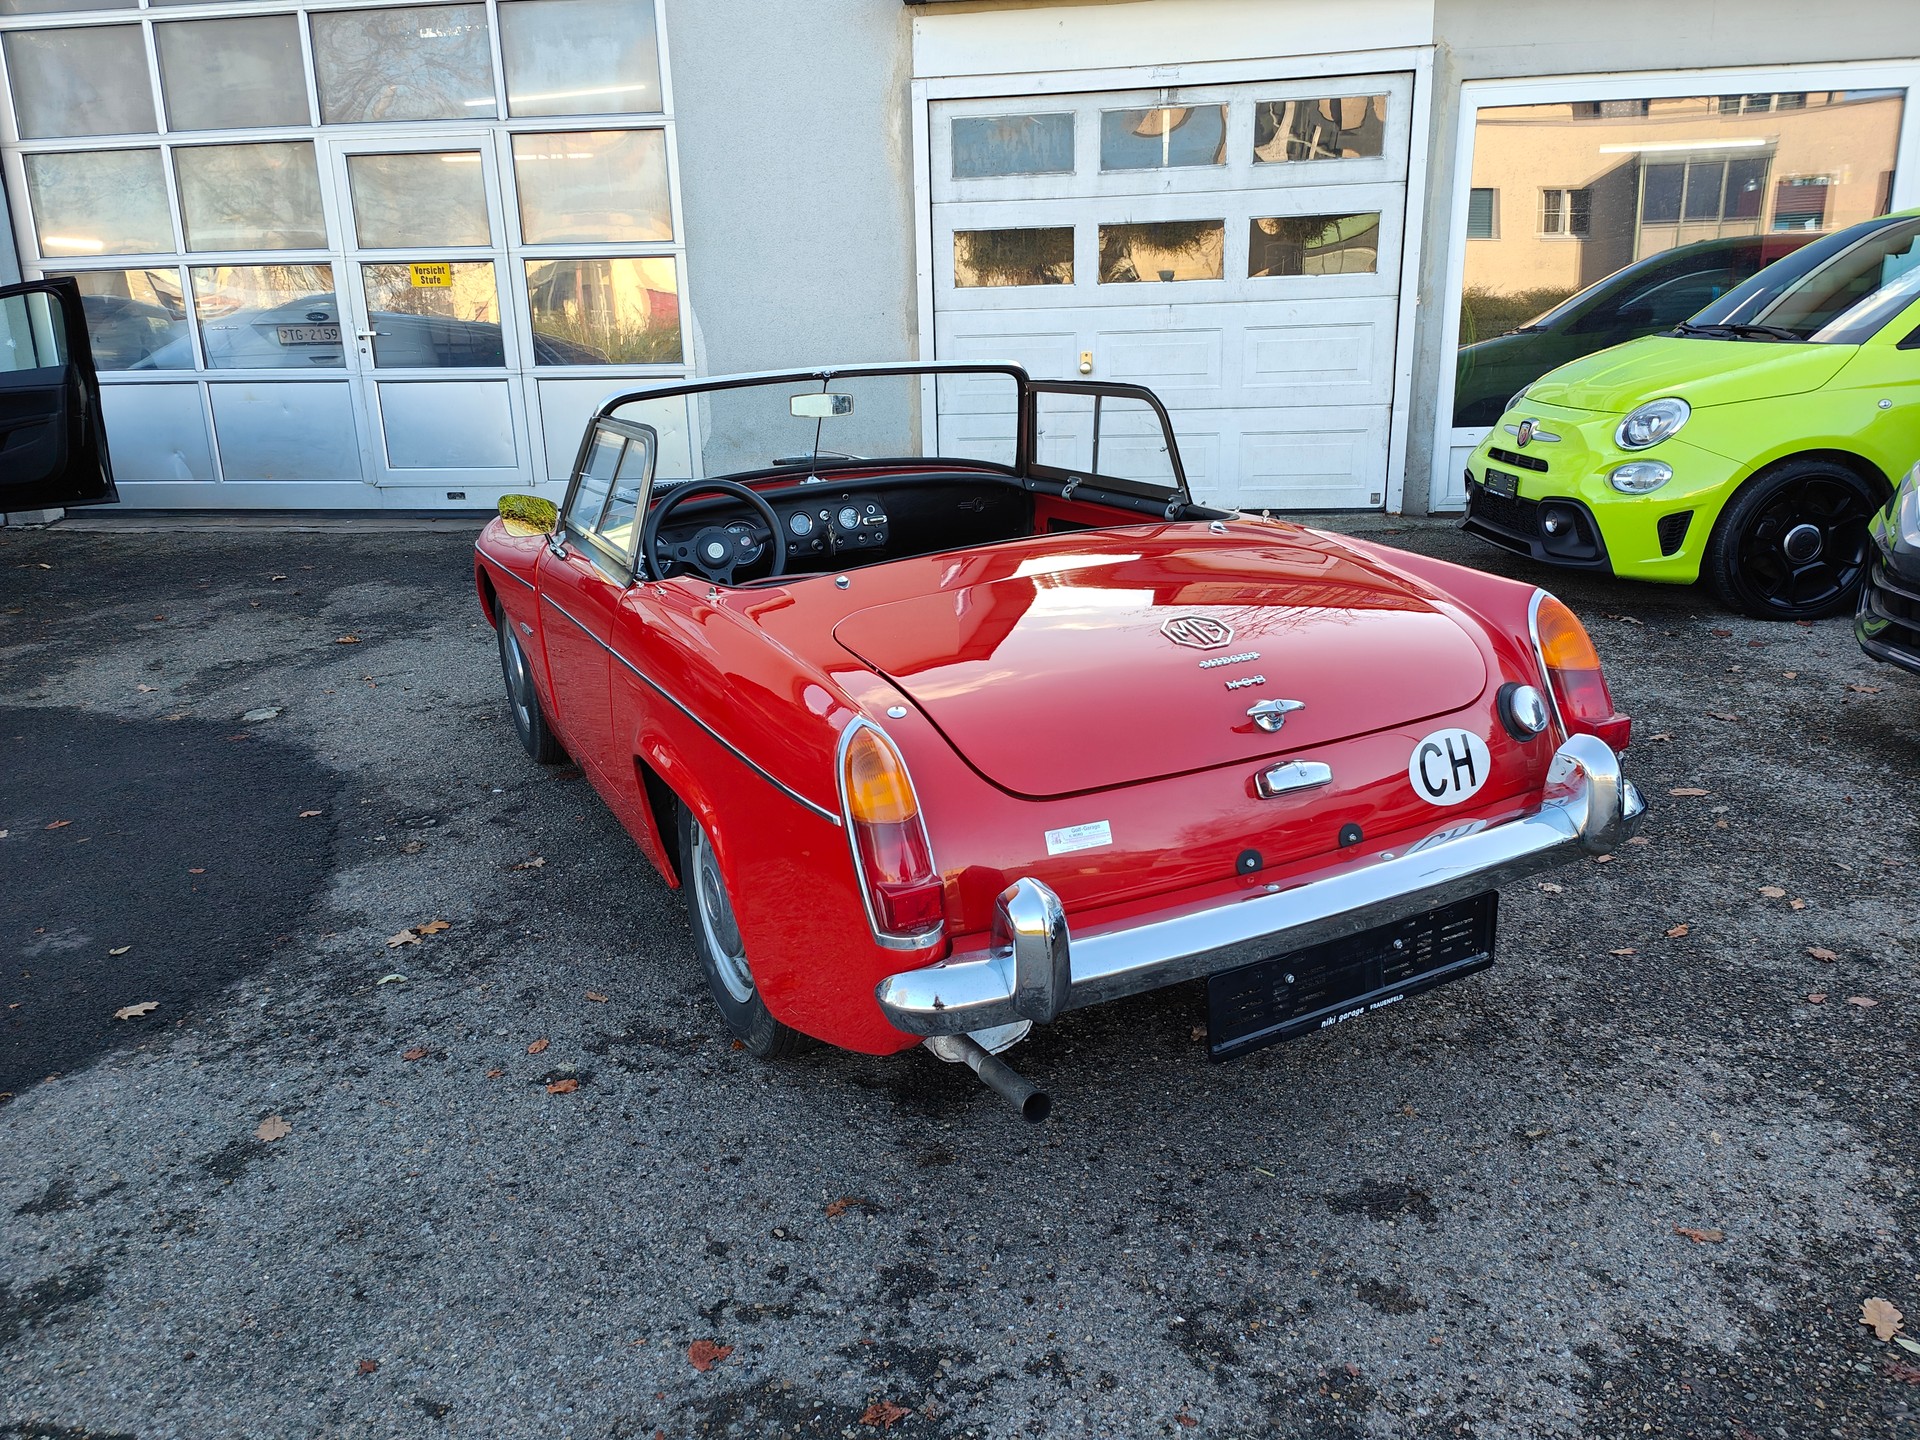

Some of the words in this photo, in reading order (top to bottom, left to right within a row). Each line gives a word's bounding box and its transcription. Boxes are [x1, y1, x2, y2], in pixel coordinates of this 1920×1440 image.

[414, 266, 445, 275] Vorsicht
[420, 275, 441, 284] Stufe
[1169, 617, 1227, 645] MG
[1419, 733, 1476, 797] CH
[1321, 1015, 1337, 1028] niki
[1338, 1007, 1365, 1023] garage
[1369, 994, 1404, 1010] FRAUENFELD
